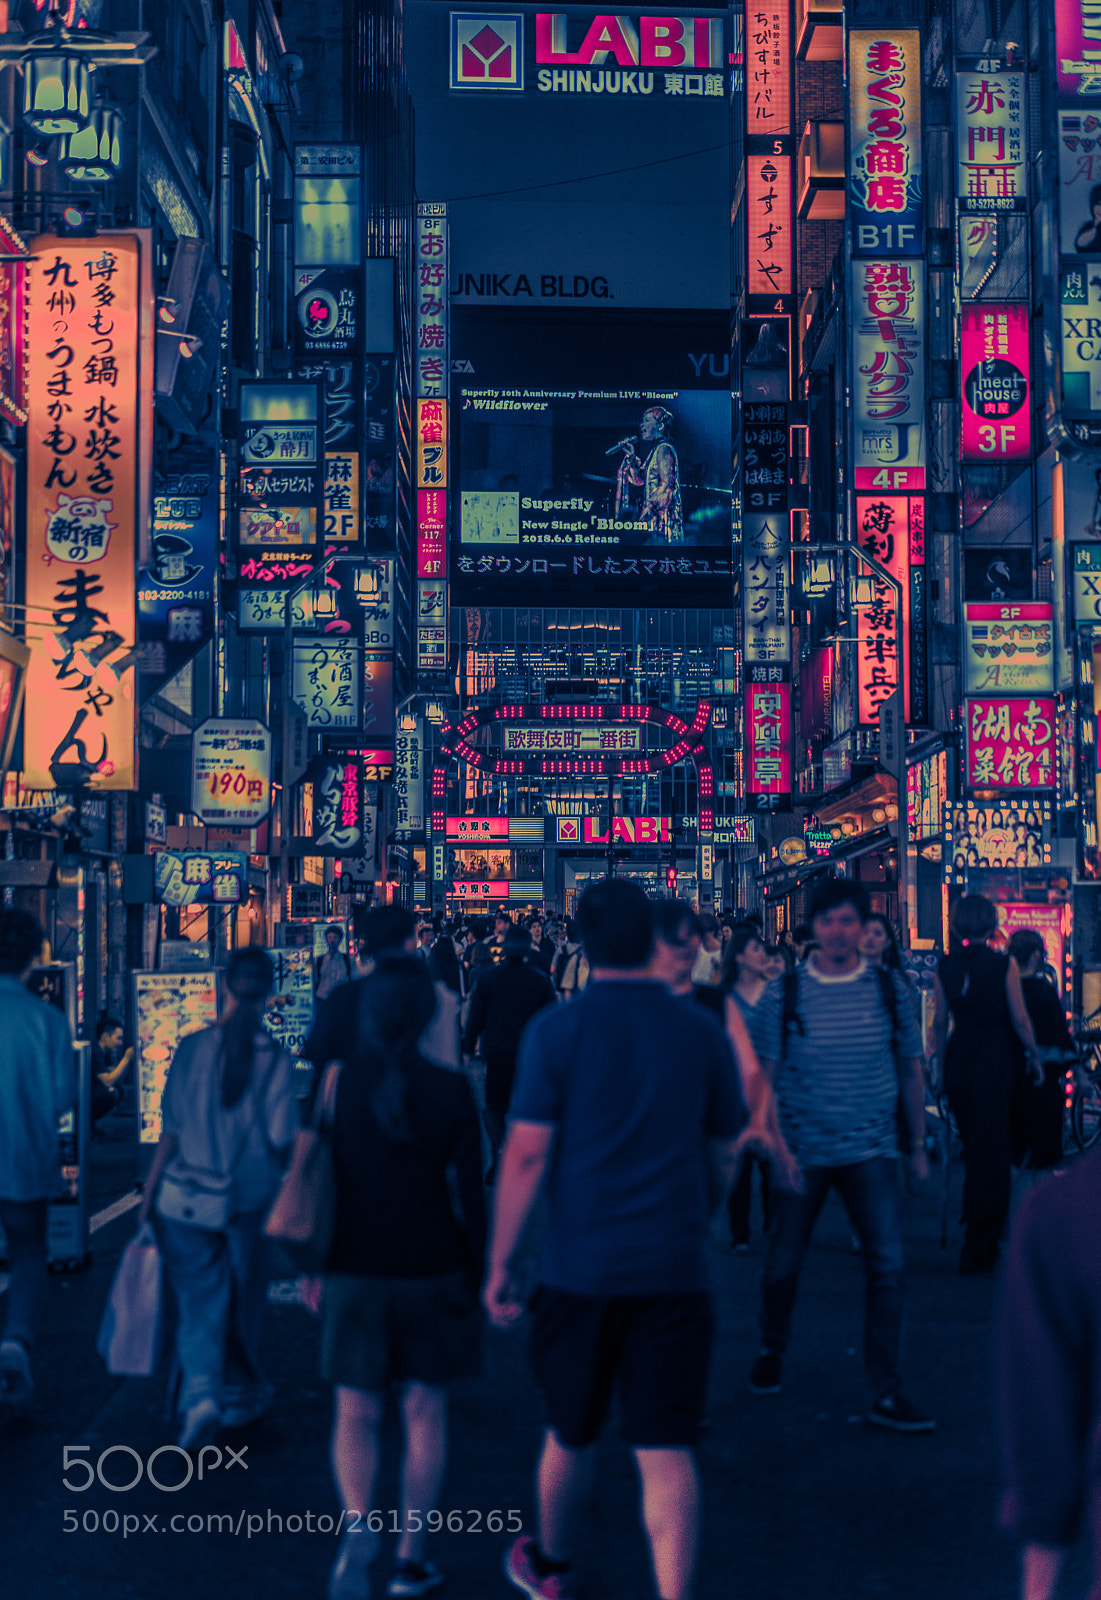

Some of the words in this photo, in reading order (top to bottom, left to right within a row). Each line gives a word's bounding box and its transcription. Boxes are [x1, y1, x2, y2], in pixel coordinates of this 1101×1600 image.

[535, 13, 723, 67] LABI
[752, 12, 774, 119] ちびすけバル
[976, 59, 1000, 72] 4F
[537, 70, 654, 93] SHINJUKU
[664, 73, 724, 96] 東口館
[1008, 76, 1020, 123] 完全個室
[864, 39, 909, 212] まぐろ商店
[965, 79, 1006, 161] 赤門
[772, 141, 783, 155] 5
[1009, 127, 1021, 161] 居酒屋
[967, 198, 1015, 209] 03-5273-8623
[424, 219, 440, 229] 8F
[757, 185, 783, 291] すずや
[858, 224, 916, 249] B1F
[541, 275, 614, 299] BLDG.
[419, 232, 445, 382] お好み焼き
[774, 299, 784, 312] 4
[82, 250, 120, 388] 博多もつ鍋
[858, 263, 921, 421] 熟女キャバクラ
[42, 255, 80, 490] 九州のうまかもん
[424, 386, 441, 396] 7F
[461, 389, 499, 398] Superfly
[523, 390, 577, 399] Anniversary
[578, 390, 617, 398] Premium
[473, 399, 549, 410] Wildflower
[744, 404, 786, 420] 小料理
[420, 400, 443, 443] 麻雀
[83, 395, 123, 495] 水炊き
[978, 424, 1016, 453] 3F
[280, 441, 309, 458] 酔月
[421, 447, 444, 484] ブル
[325, 455, 353, 511] 麻雀
[872, 469, 908, 489] 4F
[521, 497, 594, 512] Superfly
[750, 492, 781, 506] 3F
[49, 517, 107, 548] 新宿
[325, 514, 355, 537] 2F
[423, 530, 440, 540] 117
[521, 520, 549, 529] New
[551, 520, 588, 531] Single
[522, 534, 573, 543] 2018.6.6
[574, 534, 620, 543] Release
[68, 544, 89, 561] の
[423, 560, 441, 573] 4F
[1000, 608, 1021, 619] 2F
[420, 630, 444, 640] たばこ
[990, 623, 1051, 641] タイ古式
[758, 650, 776, 660] 3F
[971, 642, 1051, 659] マッサージ
[331, 639, 354, 707] 居酒屋
[752, 667, 783, 682] 焼肉
[972, 699, 1053, 747] 湖南
[507, 730, 637, 749] 歌舞伎町一番街
[753, 691, 782, 785] 安楽亭
[365, 766, 393, 780] 2F
[210, 772, 263, 797] 190円
[757, 794, 780, 809] 2F
[584, 817, 673, 843] LABI
[214, 860, 241, 870] フリー
